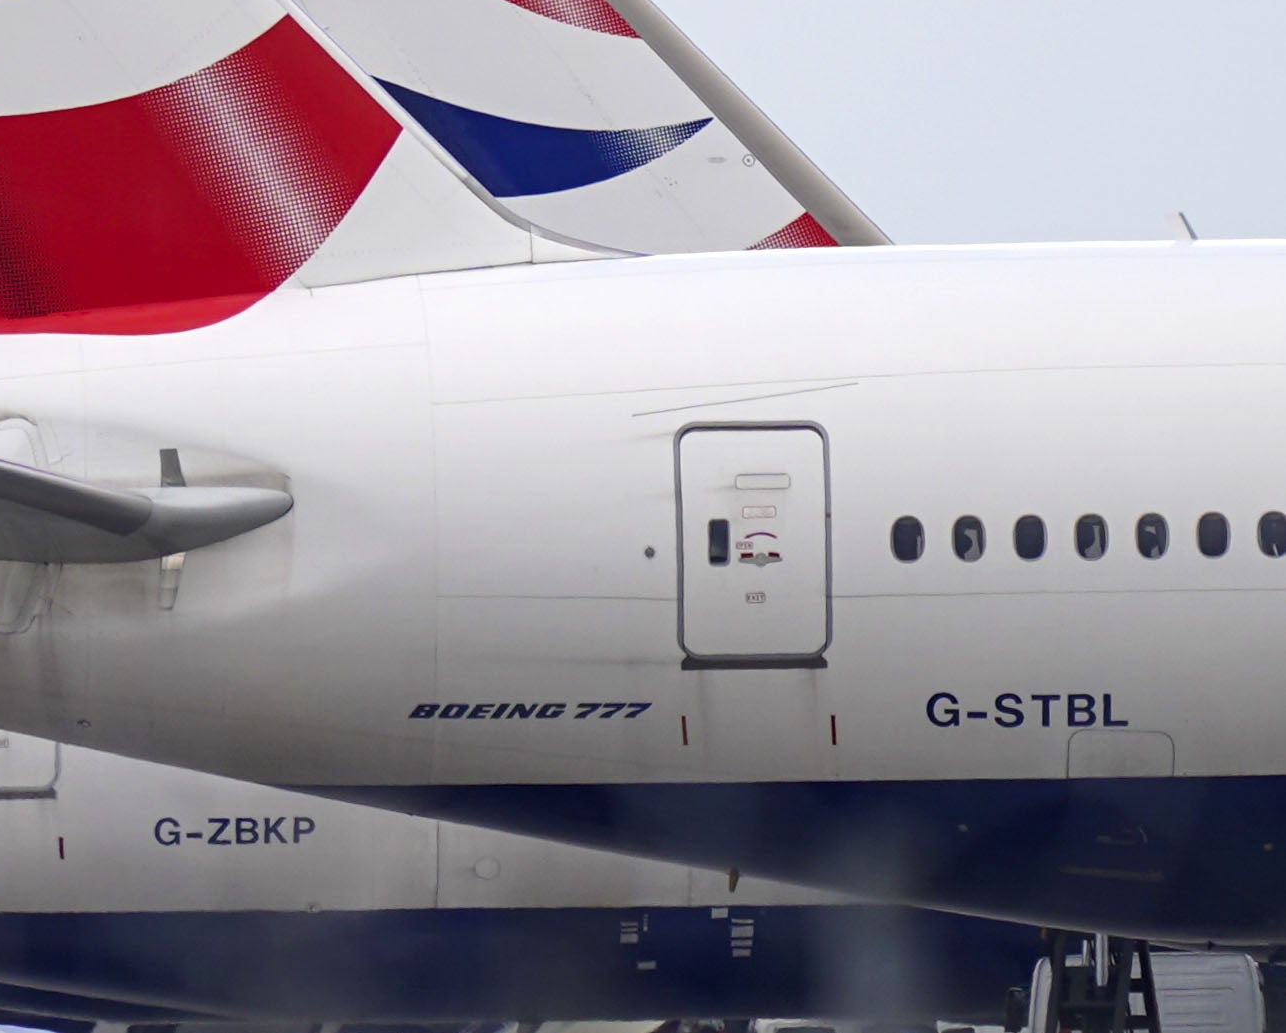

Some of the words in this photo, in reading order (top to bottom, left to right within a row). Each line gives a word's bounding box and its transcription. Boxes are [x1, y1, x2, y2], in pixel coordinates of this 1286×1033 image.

[408, 703, 565, 720] BOEING
[572, 702, 653, 719] 777
[926, 692, 1129, 728] G-STBL
[154, 816, 317, 847] G-ZBKP
